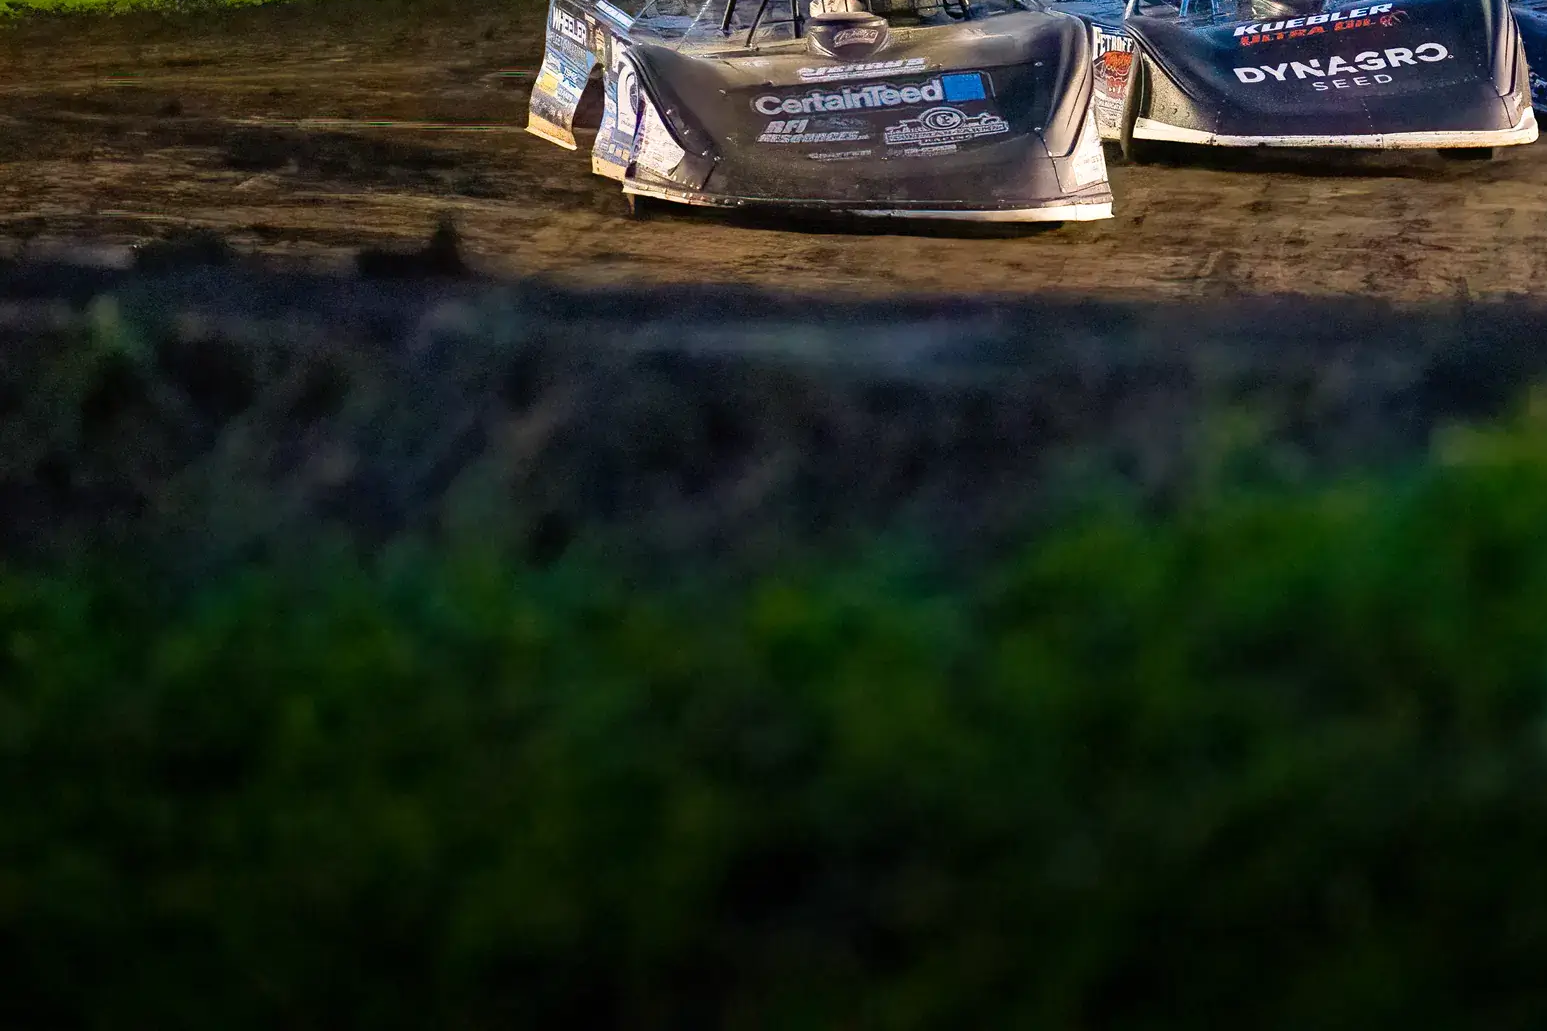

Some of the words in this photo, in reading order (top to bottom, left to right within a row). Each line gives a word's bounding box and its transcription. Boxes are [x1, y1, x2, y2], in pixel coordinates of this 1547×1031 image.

[551, 5, 588, 48] WHEELER
[1233, 3, 1393, 37] KUEBLER
[1233, 42, 1449, 84] DYNAGRO
[754, 79, 944, 116] CertainTeed
[1312, 73, 1393, 91] SEED
